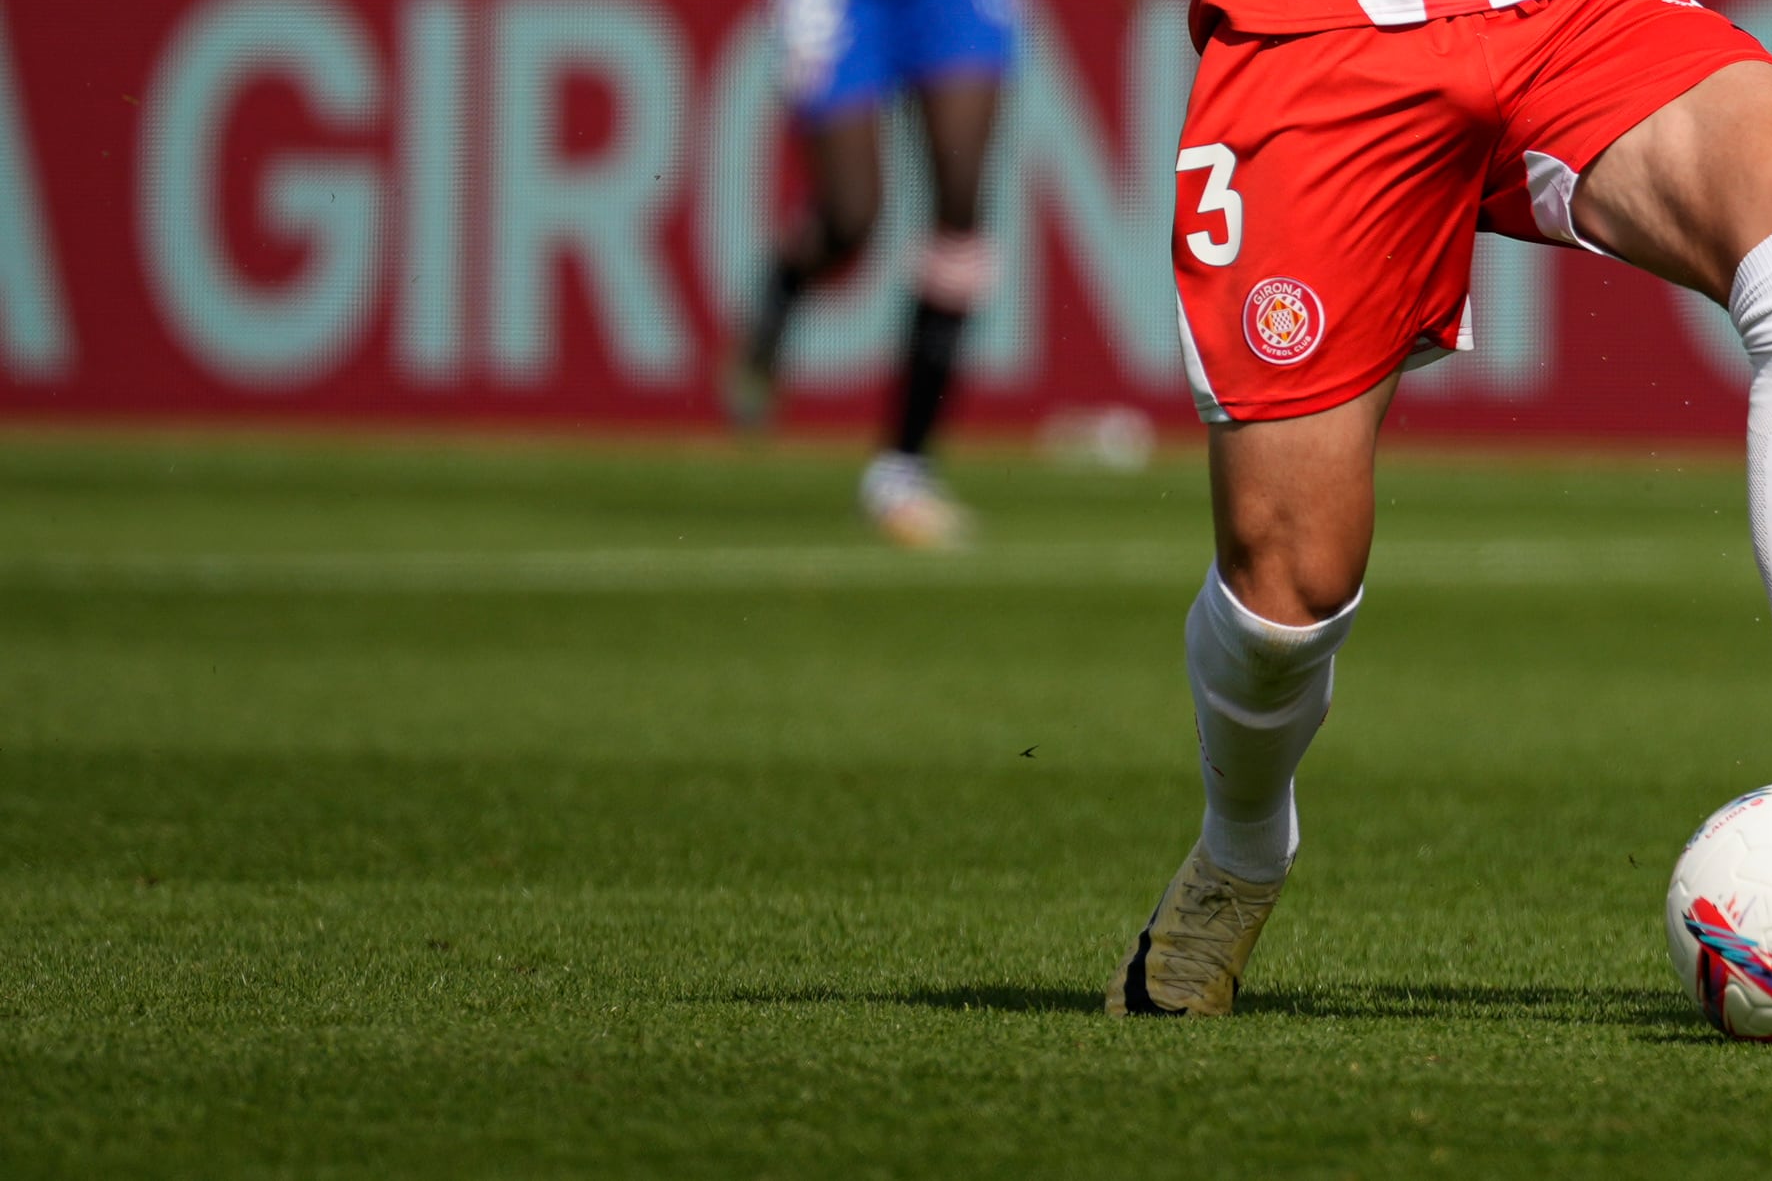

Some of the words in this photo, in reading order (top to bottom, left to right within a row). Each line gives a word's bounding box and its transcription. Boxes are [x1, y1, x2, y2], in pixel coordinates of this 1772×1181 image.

[1176, 142, 1244, 267] 3
[1253, 282, 1303, 306] GIRONA
[1262, 344, 1294, 356] FUTBOL
[1294, 335, 1313, 353] CLUB
